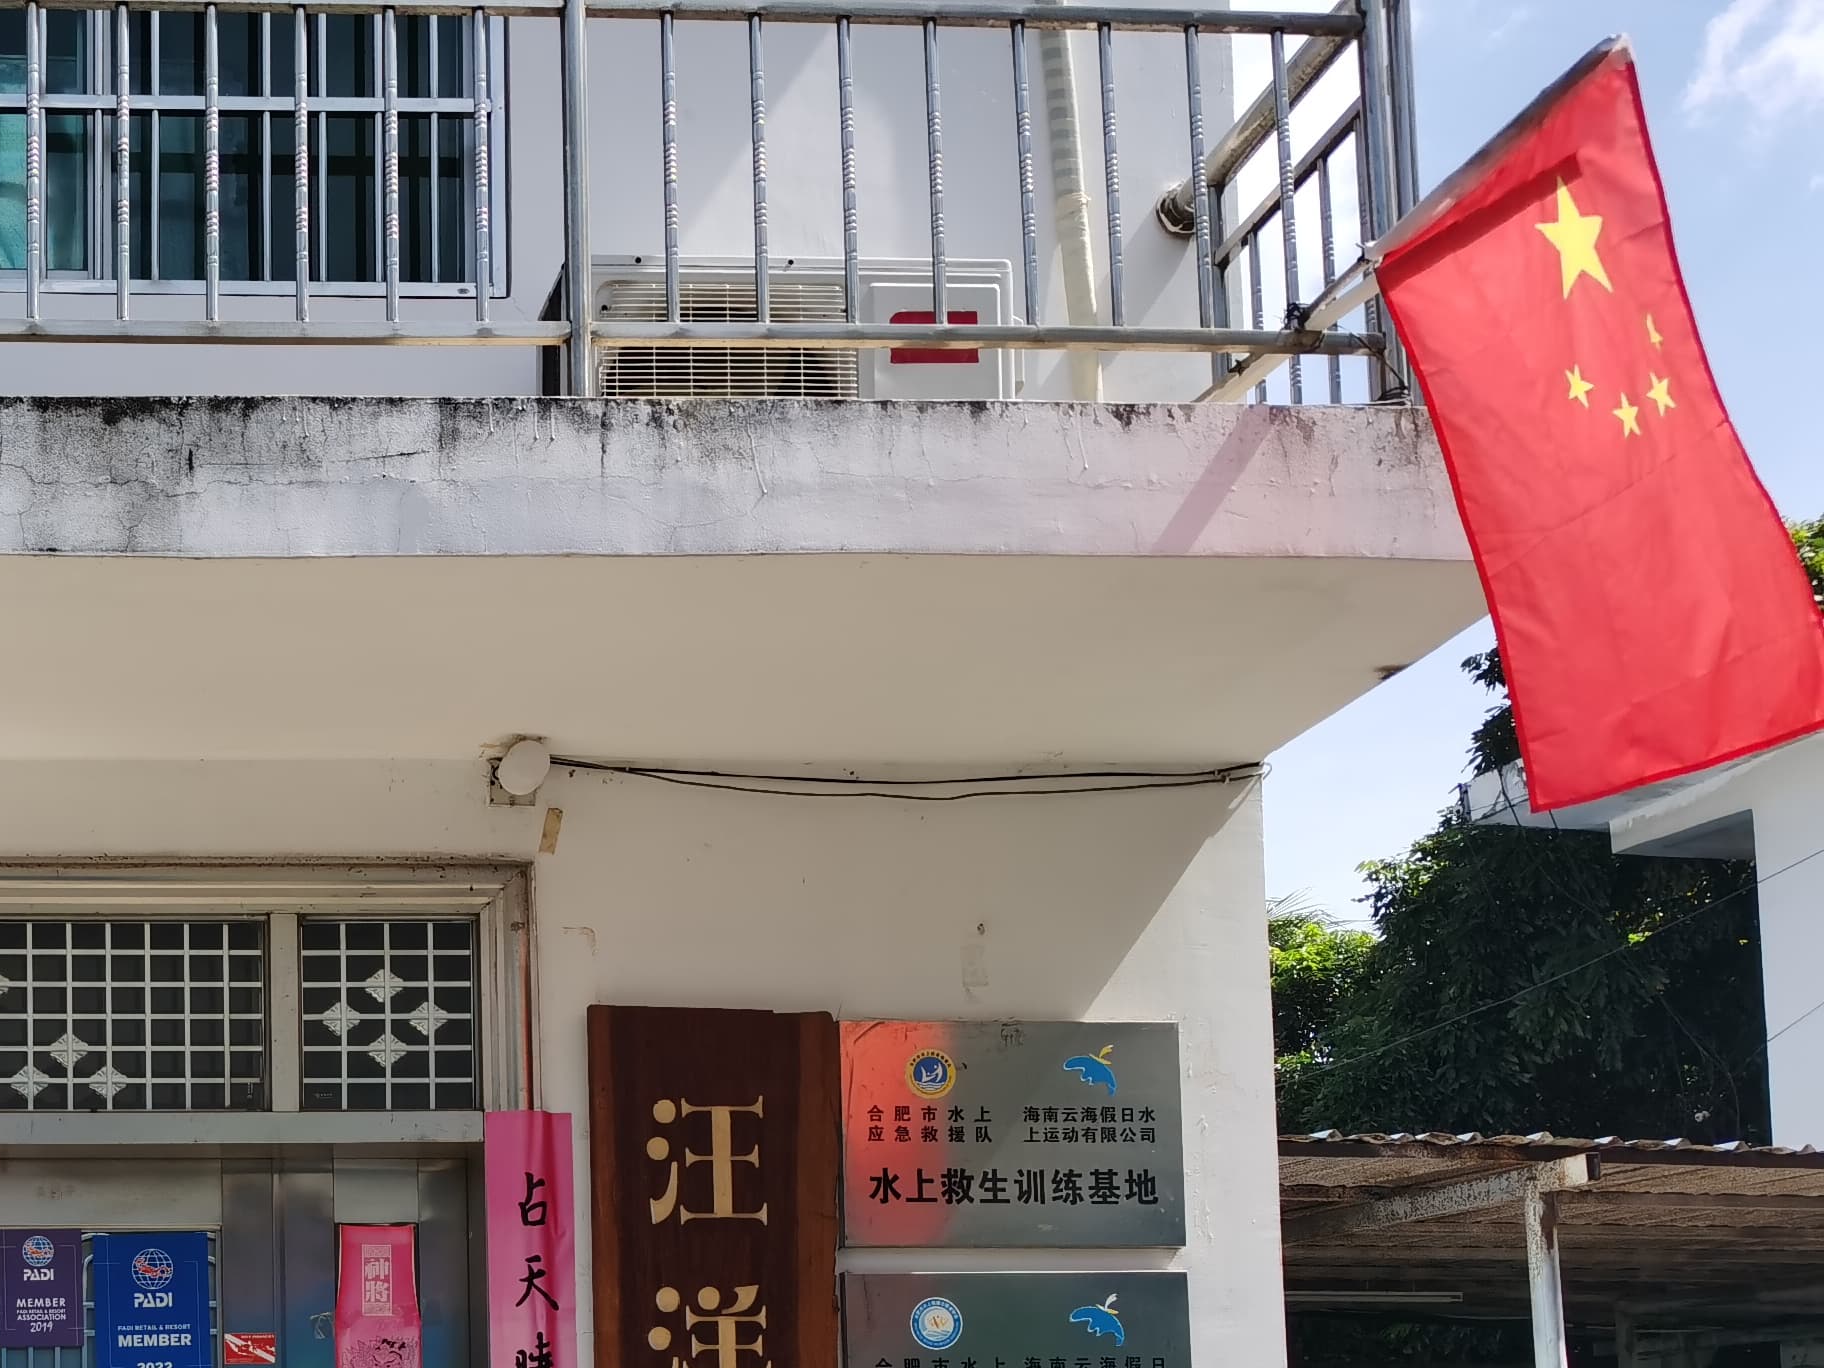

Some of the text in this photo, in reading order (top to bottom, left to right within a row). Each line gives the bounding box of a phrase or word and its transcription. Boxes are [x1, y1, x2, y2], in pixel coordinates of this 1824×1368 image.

[867, 1105, 1157, 1123] 合肥市水上 海南云海假日水
[867, 1125, 1157, 1144] 应急救援队 上运动有限公司
[869, 1167, 1159, 1206] 水上救生训练基地
[23, 1269, 55, 1282] PADI
[16, 1298, 66, 1309] MEMBER
[133, 1292, 173, 1308] PADI
[165, 1323, 191, 1331] RESORT
[117, 1334, 192, 1348] MEMBER
